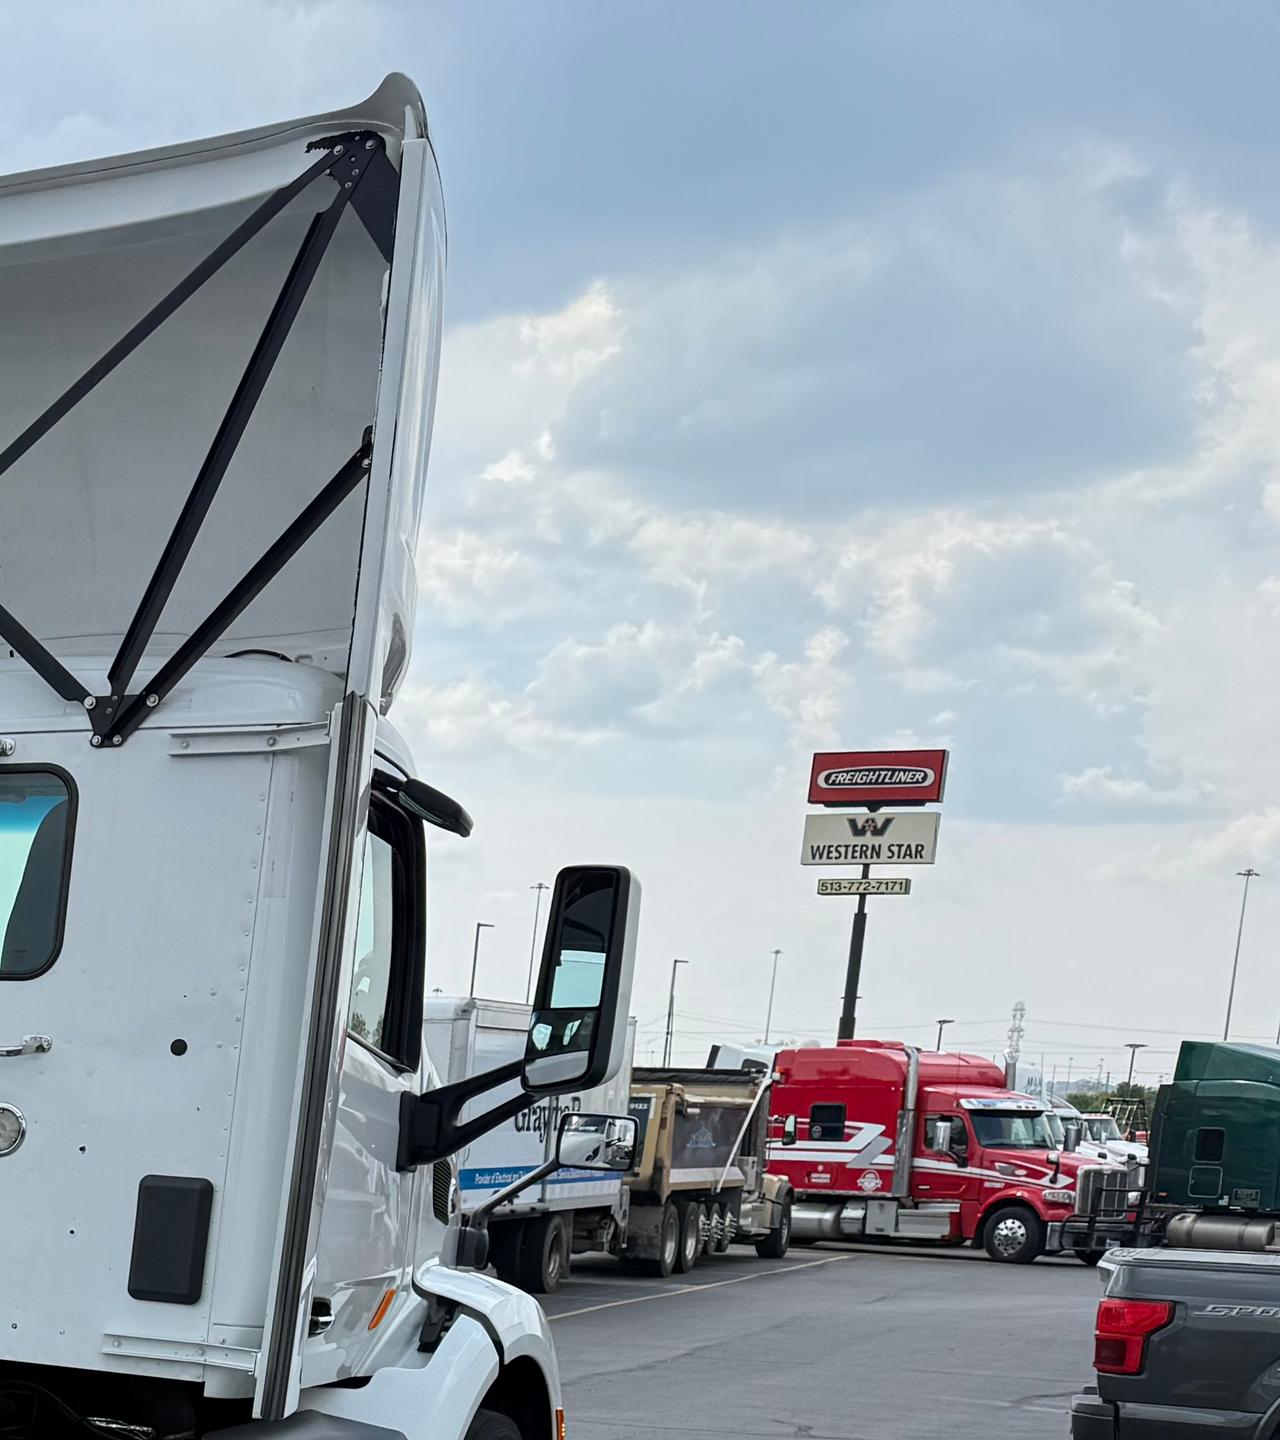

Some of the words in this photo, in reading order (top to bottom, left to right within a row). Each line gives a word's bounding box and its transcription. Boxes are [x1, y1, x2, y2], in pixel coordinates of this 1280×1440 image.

[828, 770, 925, 785] FREIGHTLINER
[810, 843, 882, 861] WESTERN
[887, 843, 925, 860] STAR
[820, 881, 904, 892] 513-772-7171
